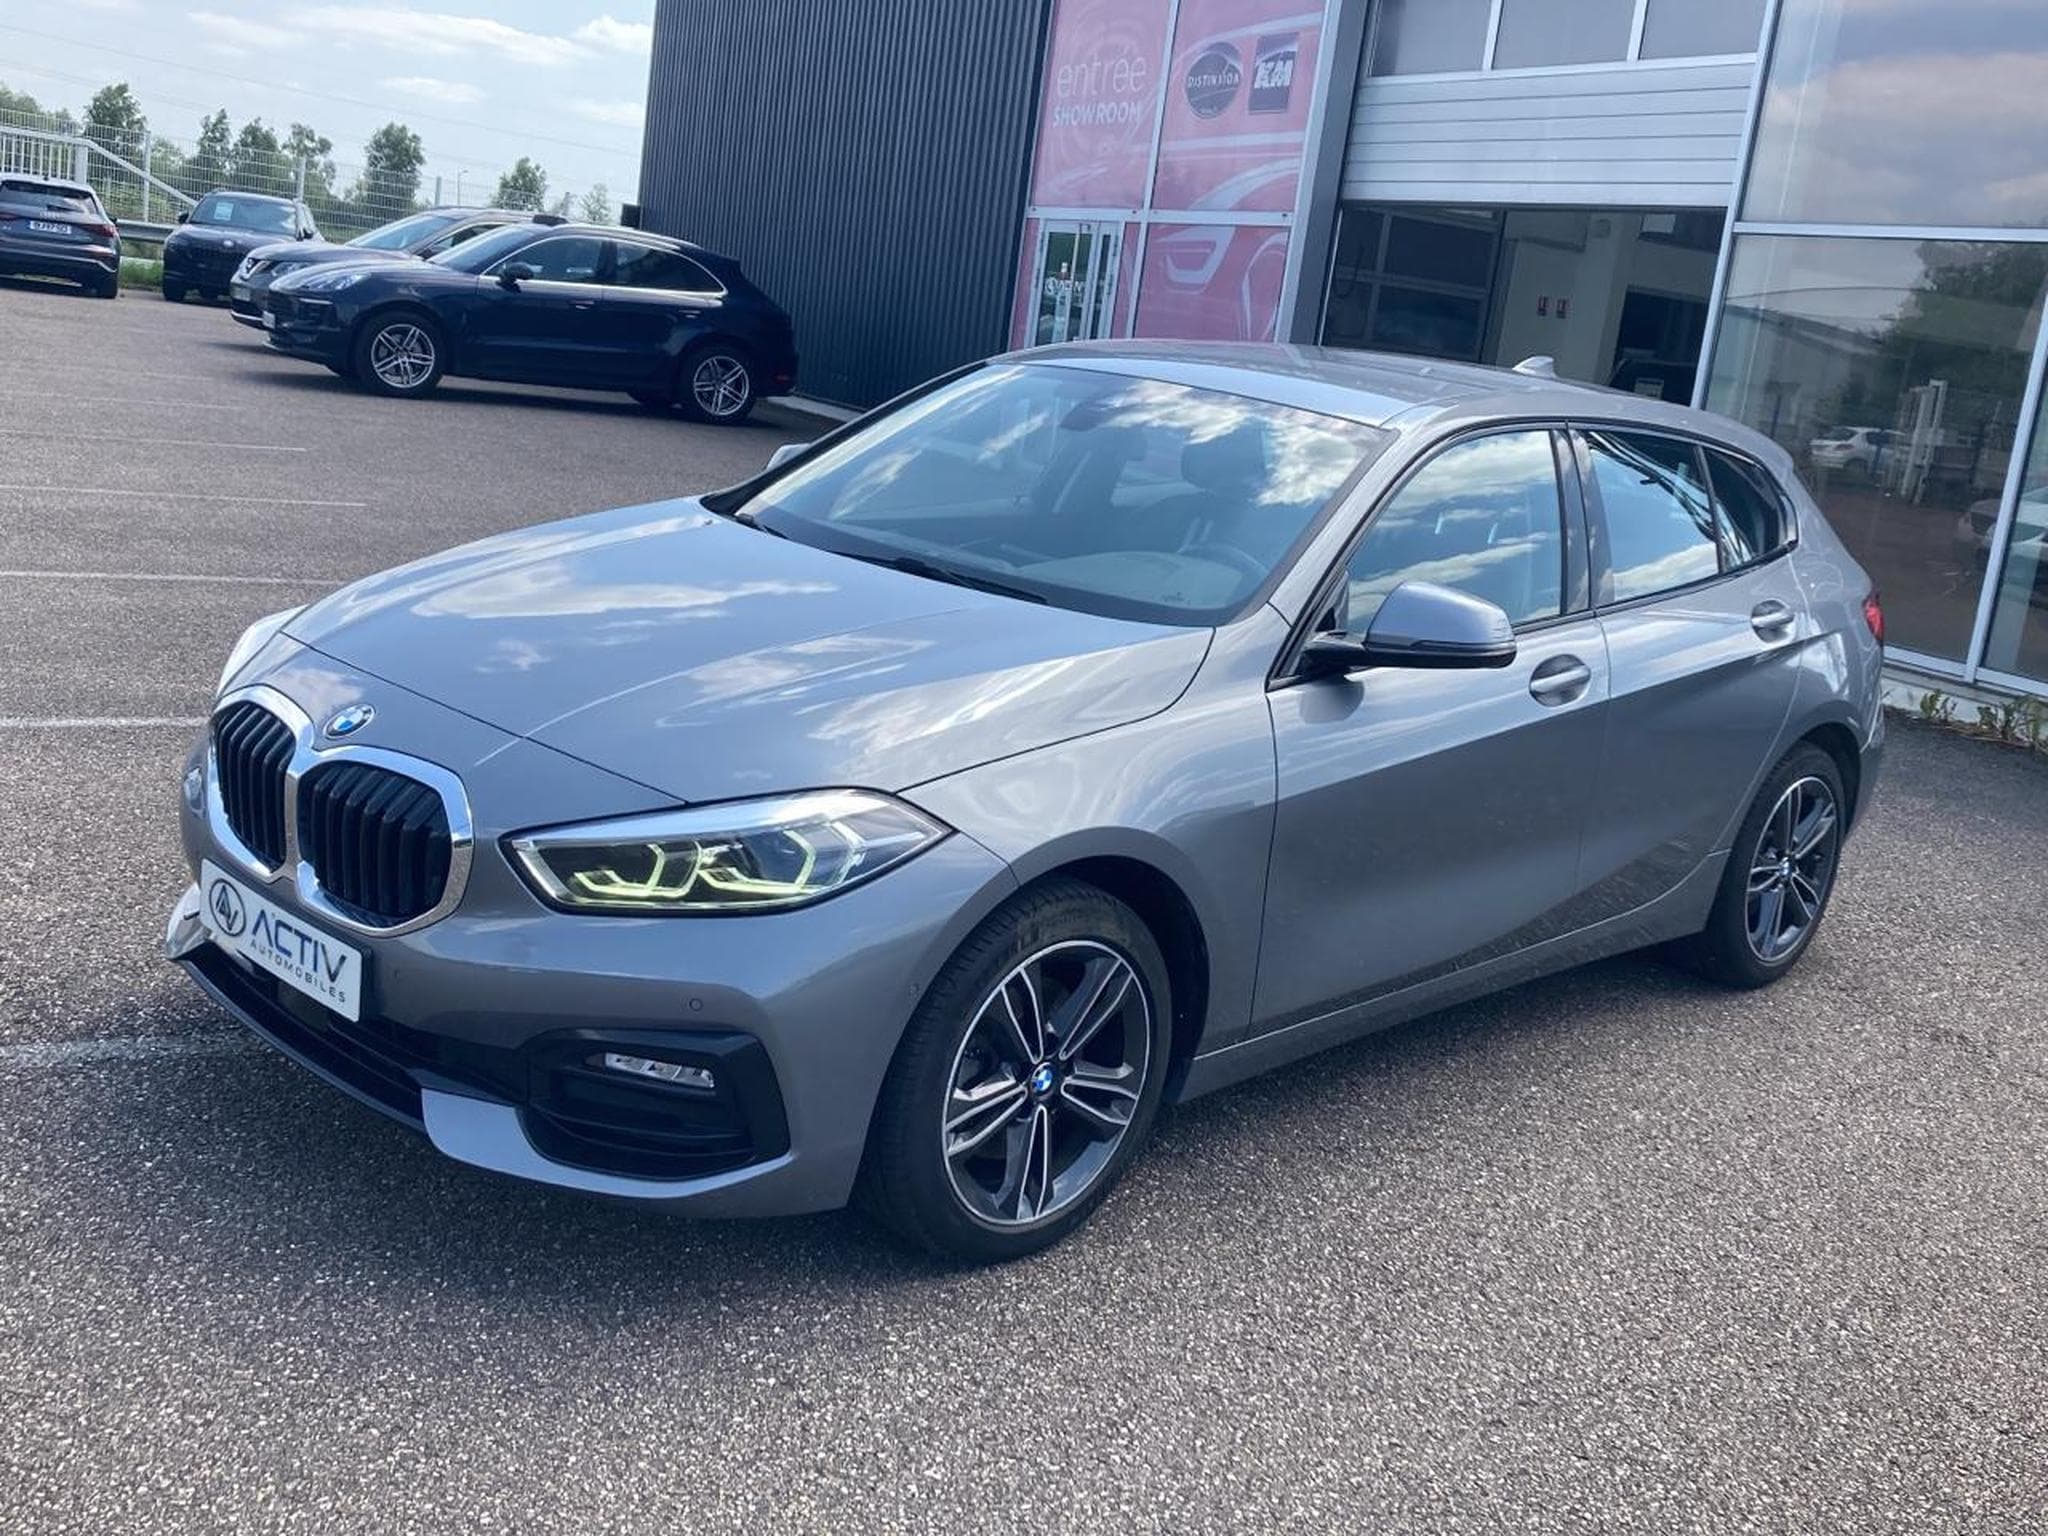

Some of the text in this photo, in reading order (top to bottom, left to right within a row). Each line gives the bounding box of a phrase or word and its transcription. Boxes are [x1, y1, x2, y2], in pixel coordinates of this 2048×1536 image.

[1057, 47, 1146, 98] entrée
[1053, 101, 1141, 128] SHOWROOM
[250, 938, 346, 1003] AUTOMOBILES
[252, 909, 347, 983] ACTIV
